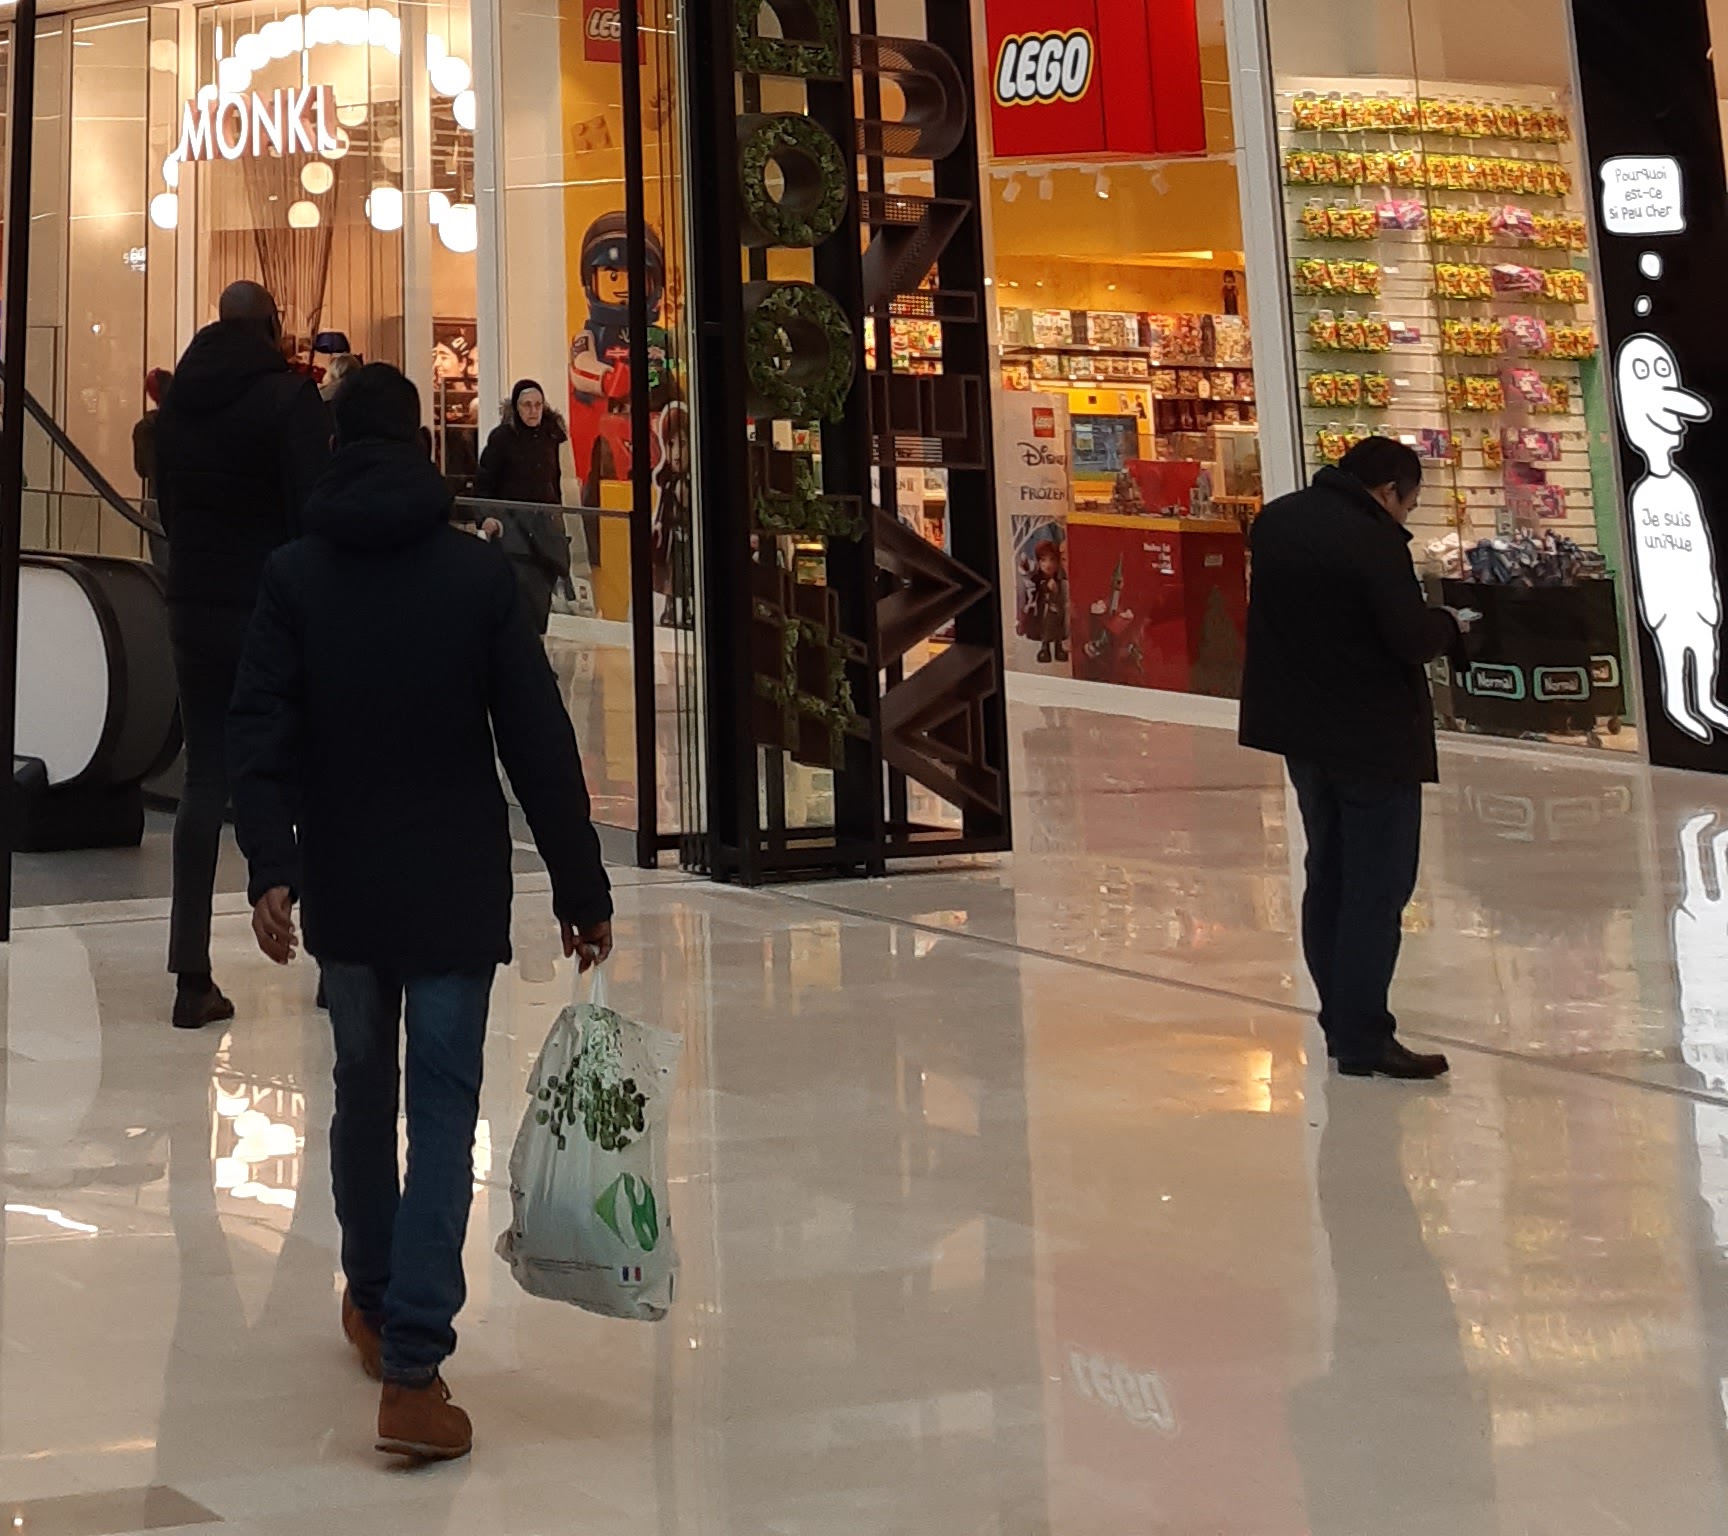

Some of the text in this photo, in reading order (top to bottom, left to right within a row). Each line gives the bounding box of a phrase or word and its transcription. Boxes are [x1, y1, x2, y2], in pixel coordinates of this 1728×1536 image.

[997, 33, 1090, 102] LEGO
[1615, 166, 1667, 183] Pourquoi
[1642, 507, 1692, 527] Je suis
[1644, 533, 1693, 552] unique
